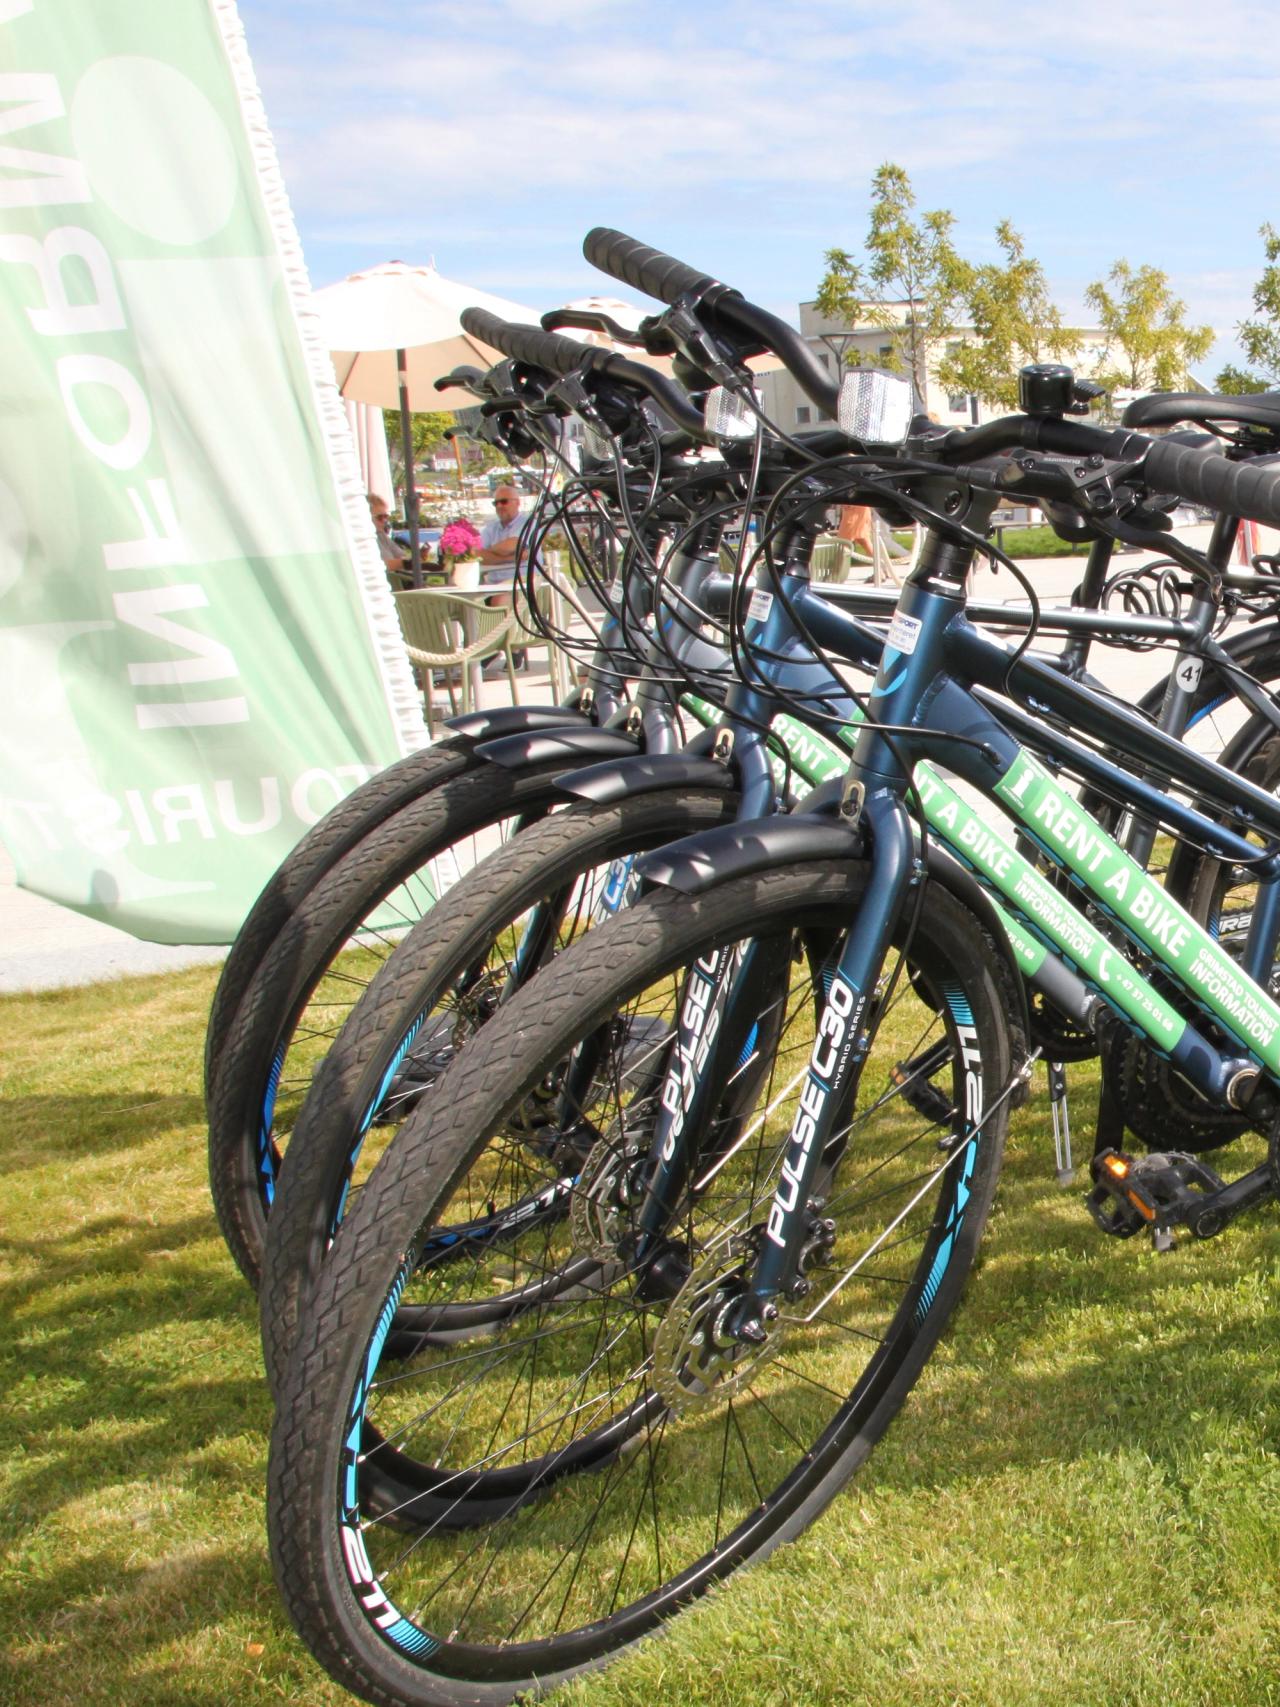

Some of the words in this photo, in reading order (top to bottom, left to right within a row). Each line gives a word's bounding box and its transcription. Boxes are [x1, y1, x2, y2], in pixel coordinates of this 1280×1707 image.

[1181, 666, 1202, 683] 41
[936, 801, 959, 829] A
[959, 818, 1015, 878] BIKE
[1035, 791, 1113, 872] RENT
[1104, 867, 1131, 901] A
[1129, 886, 1192, 958] BIKE
[1014, 881, 1092, 959] INFORMATION
[811, 977, 854, 1078] C30
[1189, 959, 1274, 1047] INFORMATION
[1199, 948, 1244, 997] GRIMSTAD
[1244, 991, 1279, 1033] TOURIST
[833, 1043, 852, 1090] HYBRID
[847, 995, 867, 1040] SERIES
[766, 1074, 827, 1248] PULSE
